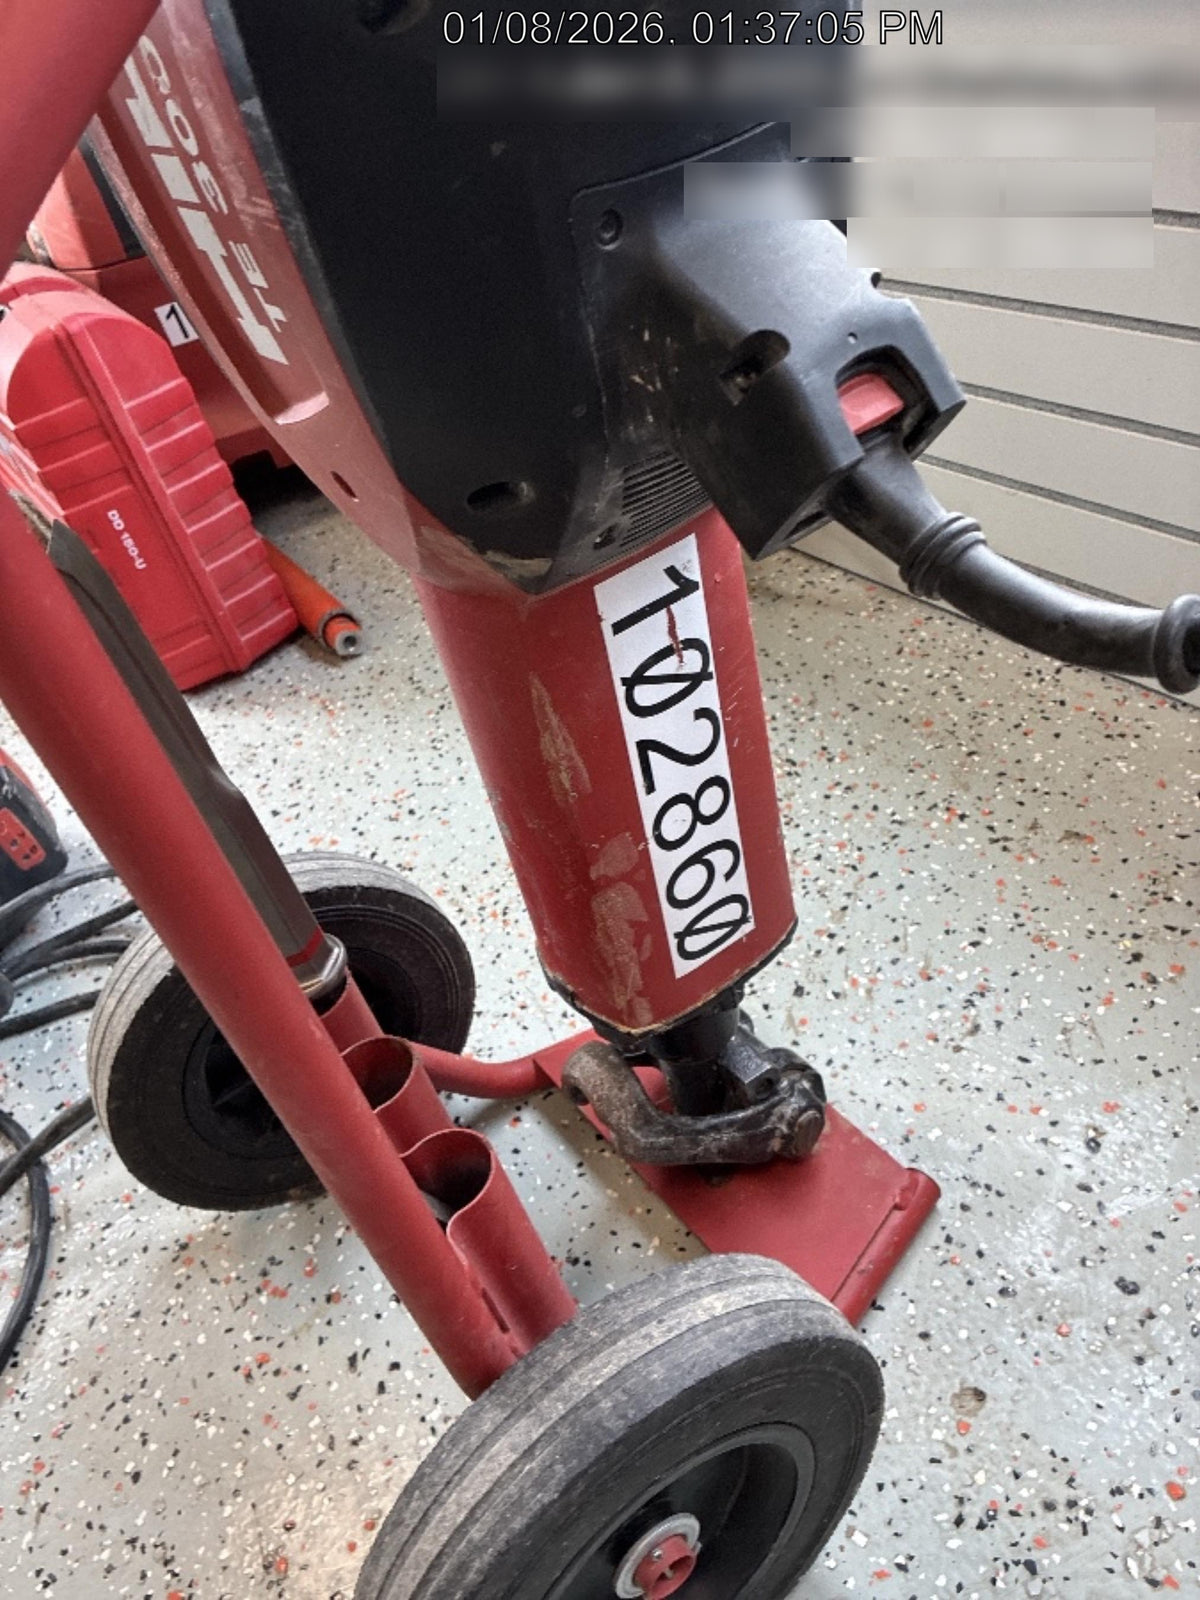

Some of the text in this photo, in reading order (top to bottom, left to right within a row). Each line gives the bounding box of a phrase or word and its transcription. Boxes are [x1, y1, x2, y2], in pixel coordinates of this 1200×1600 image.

[123, 55, 289, 365] HIL
[229, 240, 288, 333] TE
[107, 509, 125, 531] DD
[611, 564, 753, 961] 102860
